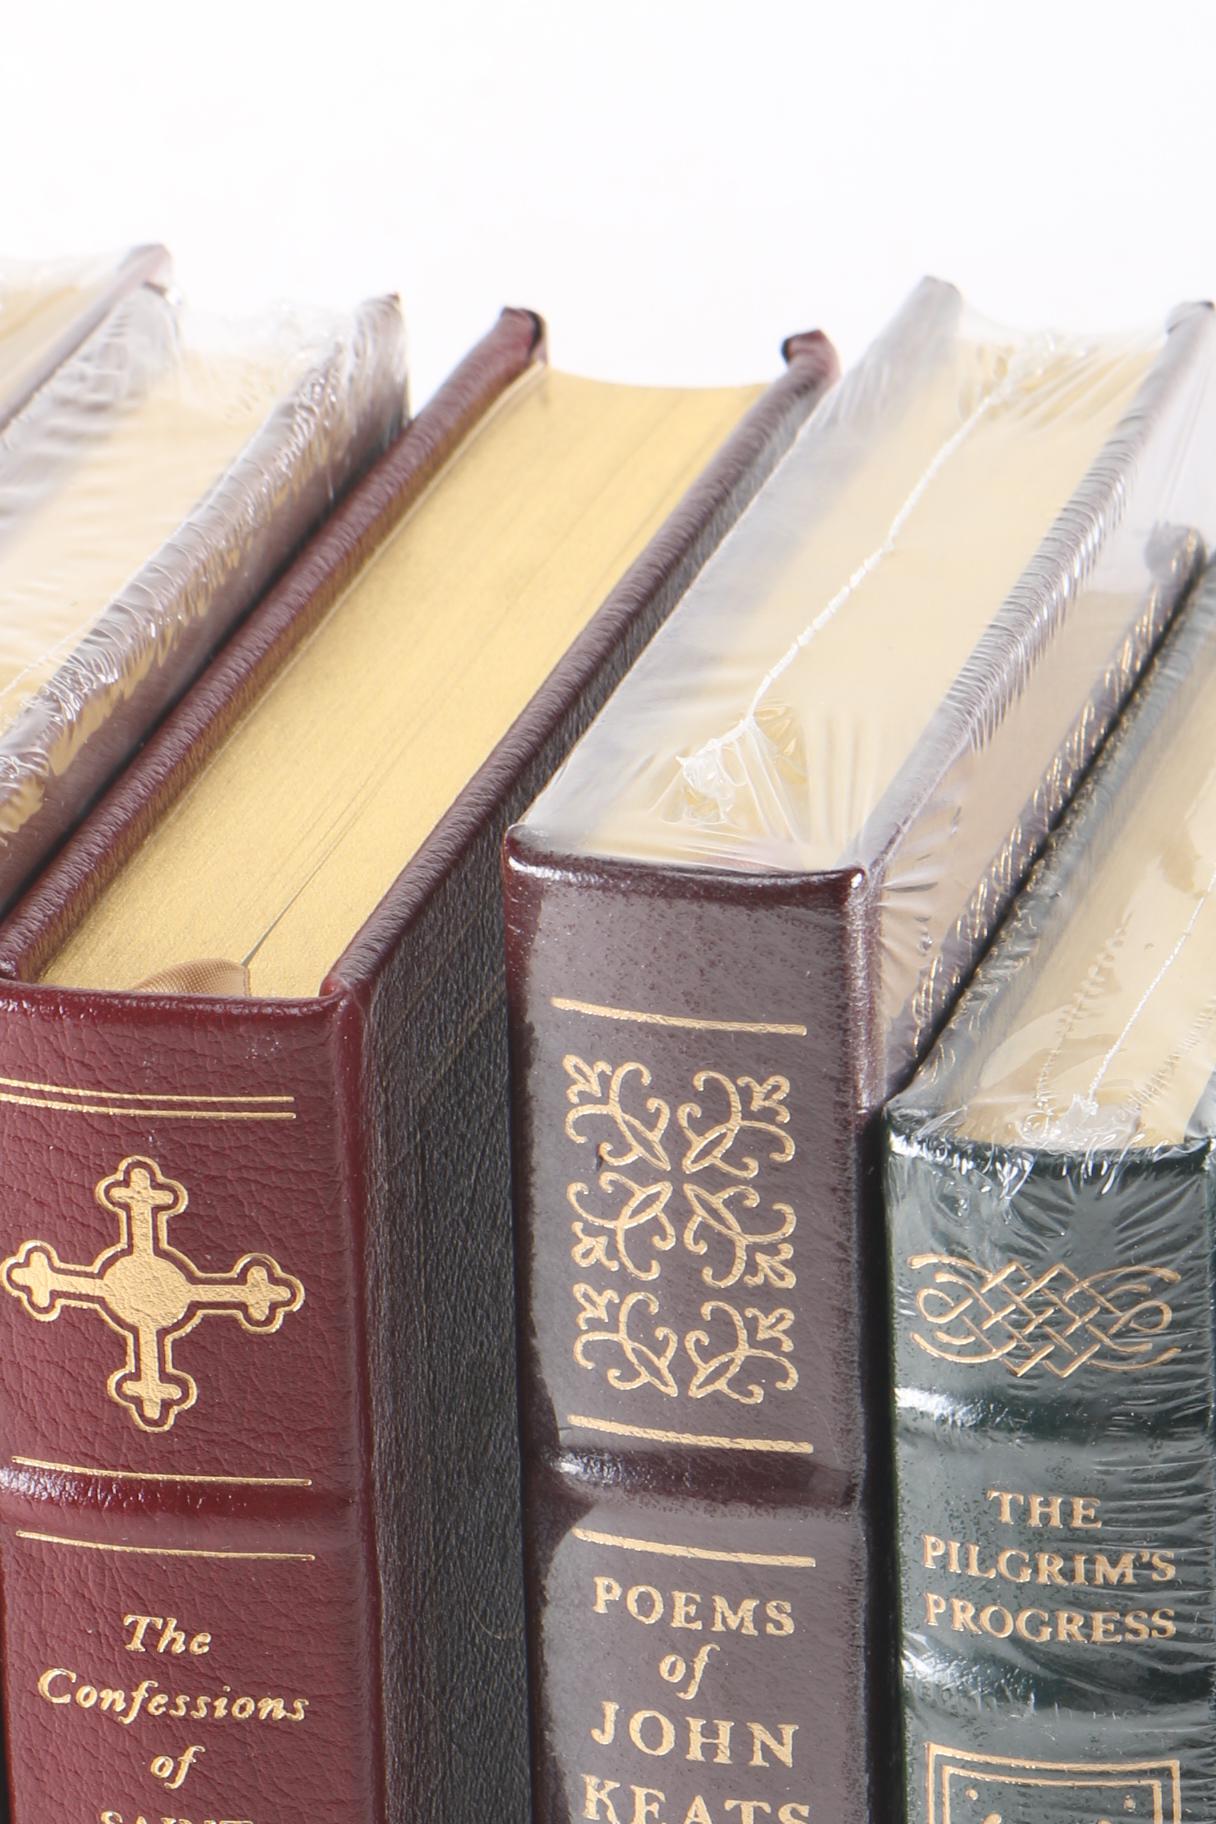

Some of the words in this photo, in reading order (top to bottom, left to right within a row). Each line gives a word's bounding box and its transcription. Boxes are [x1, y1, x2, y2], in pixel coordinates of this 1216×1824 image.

[986, 1488, 1103, 1530] THE
[922, 1534, 1177, 1586] PILGRIM'S
[592, 1575, 795, 1637] POEMS
[923, 1592, 1177, 1644] PROGRESS
[123, 1614, 212, 1655] The
[37, 1668, 310, 1725] Confessions
[658, 1642, 721, 1700] of
[590, 1700, 799, 1768] JOHN
[149, 1745, 206, 1790] of
